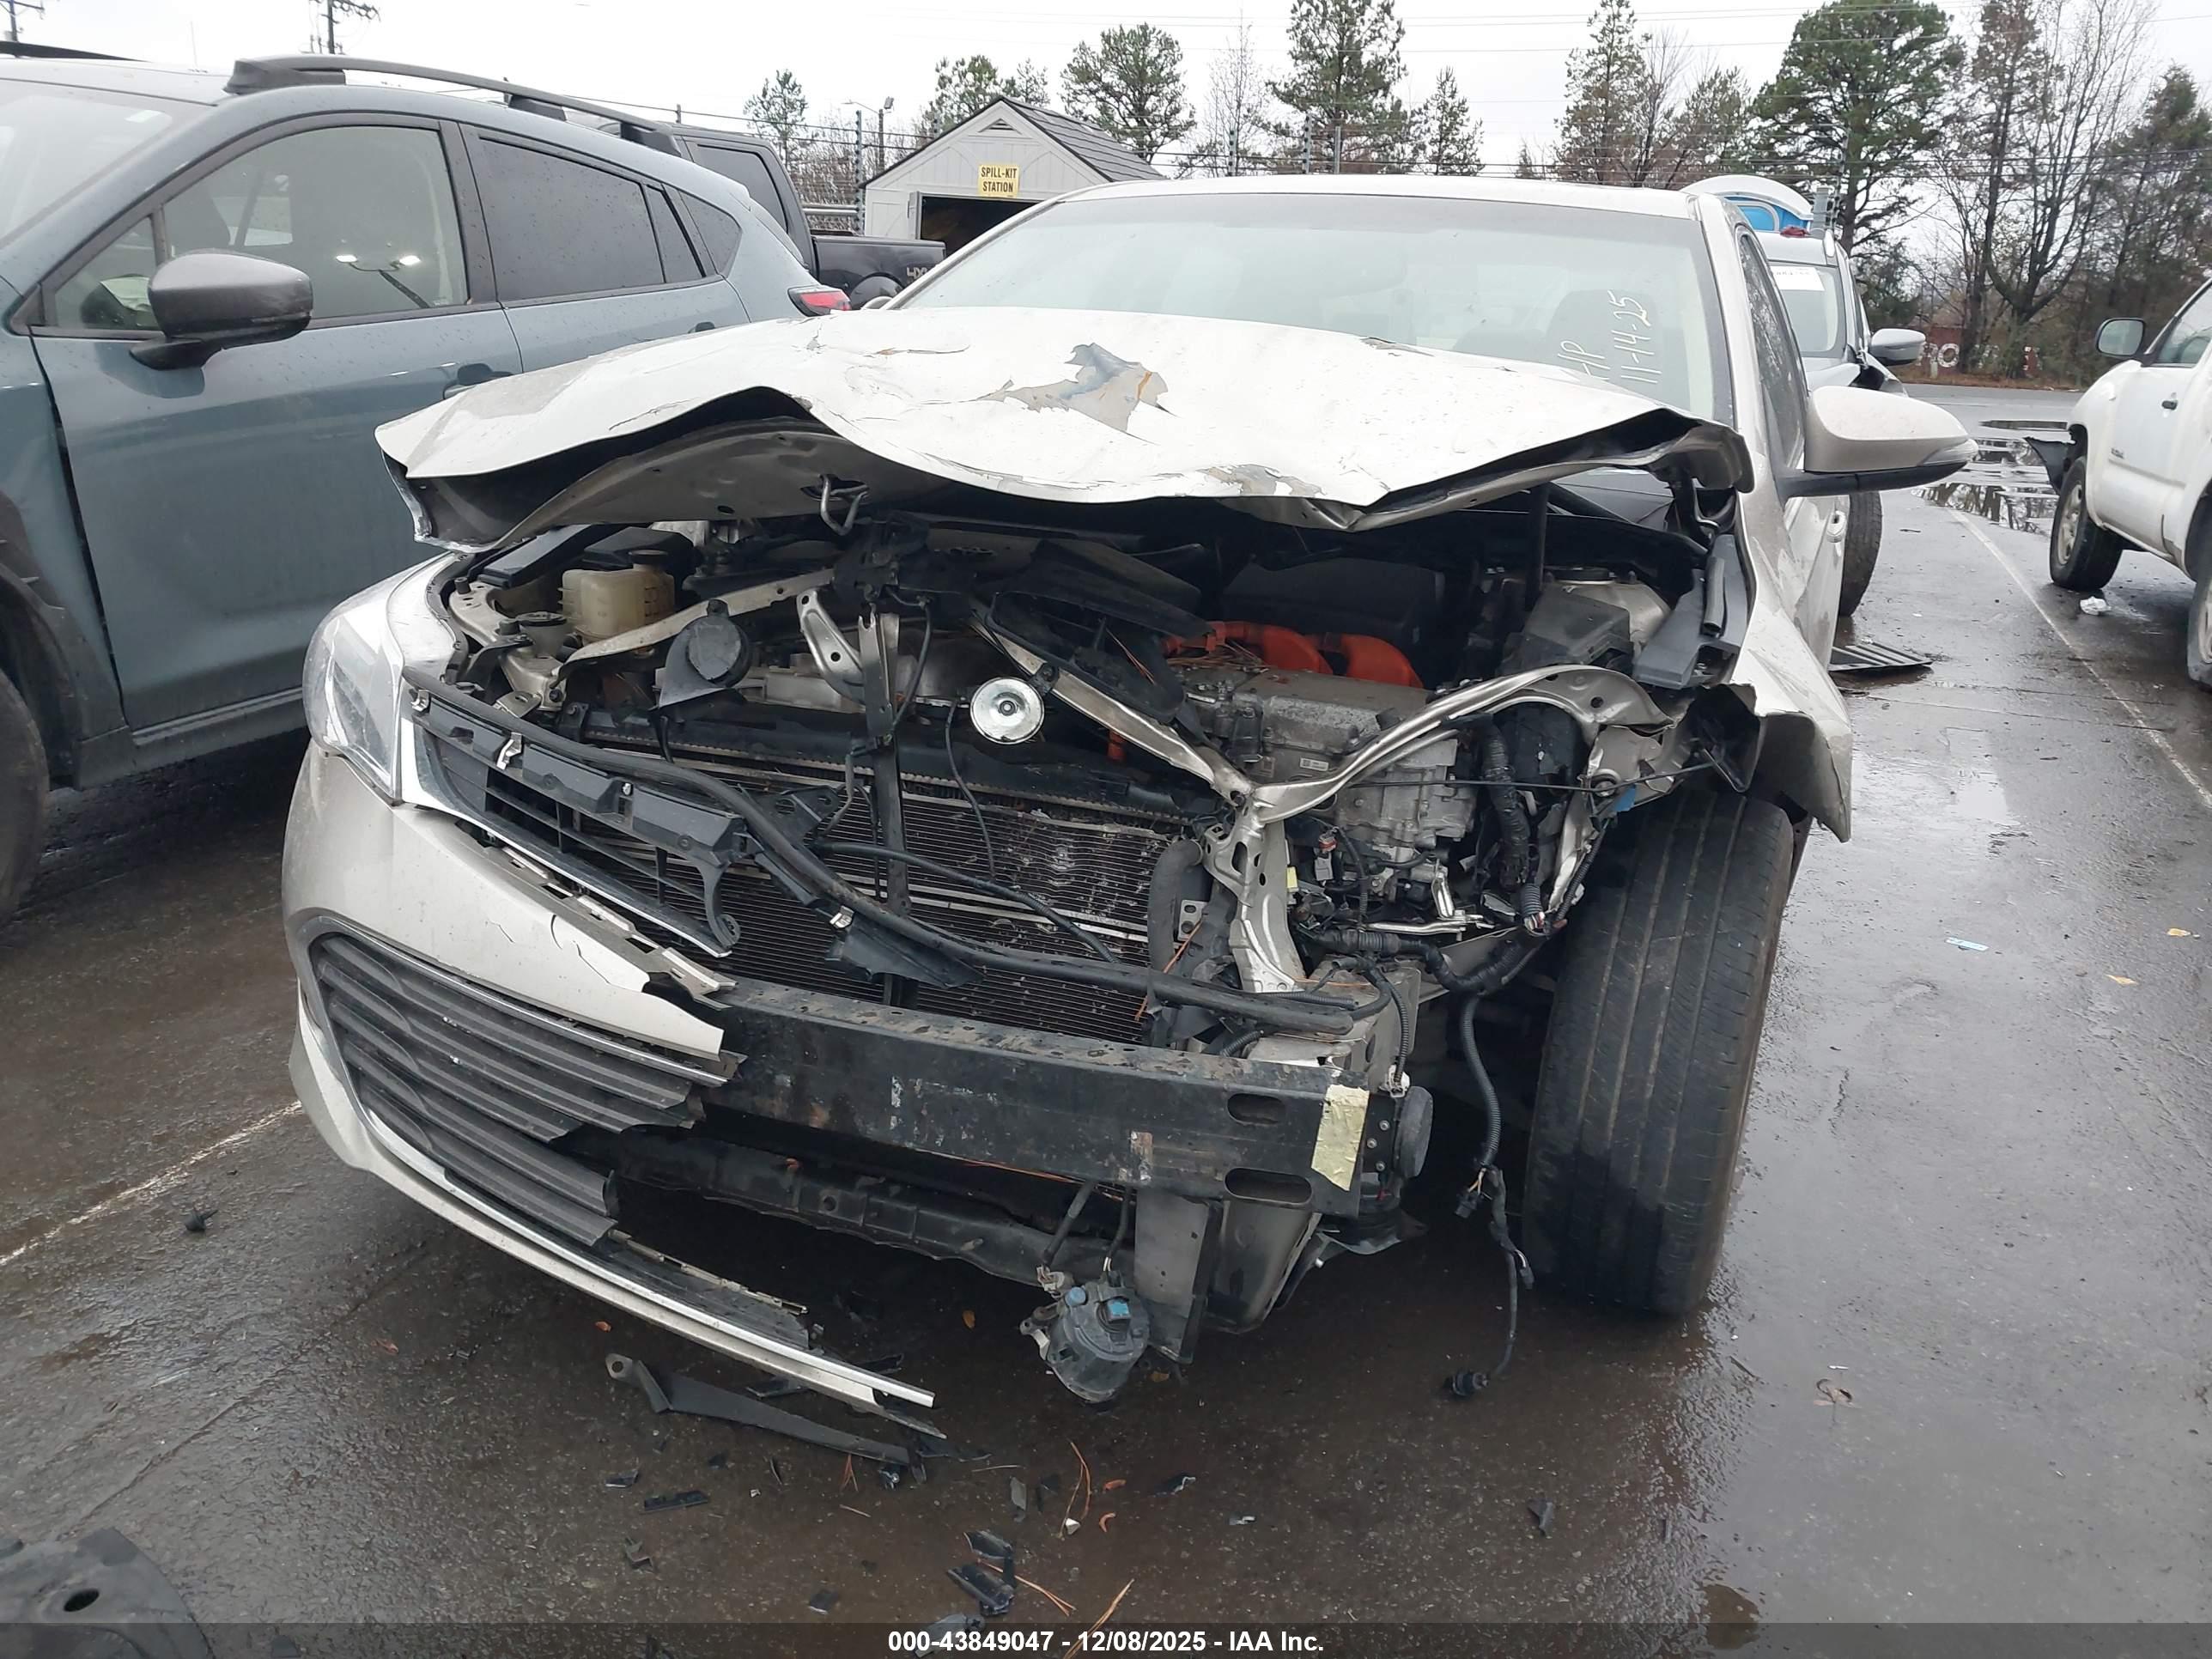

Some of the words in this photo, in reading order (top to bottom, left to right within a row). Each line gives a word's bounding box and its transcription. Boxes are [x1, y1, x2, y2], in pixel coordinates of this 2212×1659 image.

[981, 167, 1018, 179] SPILL-KIT
[982, 181, 1014, 192] STATION
[1607, 289, 1662, 384] 11-14-25
